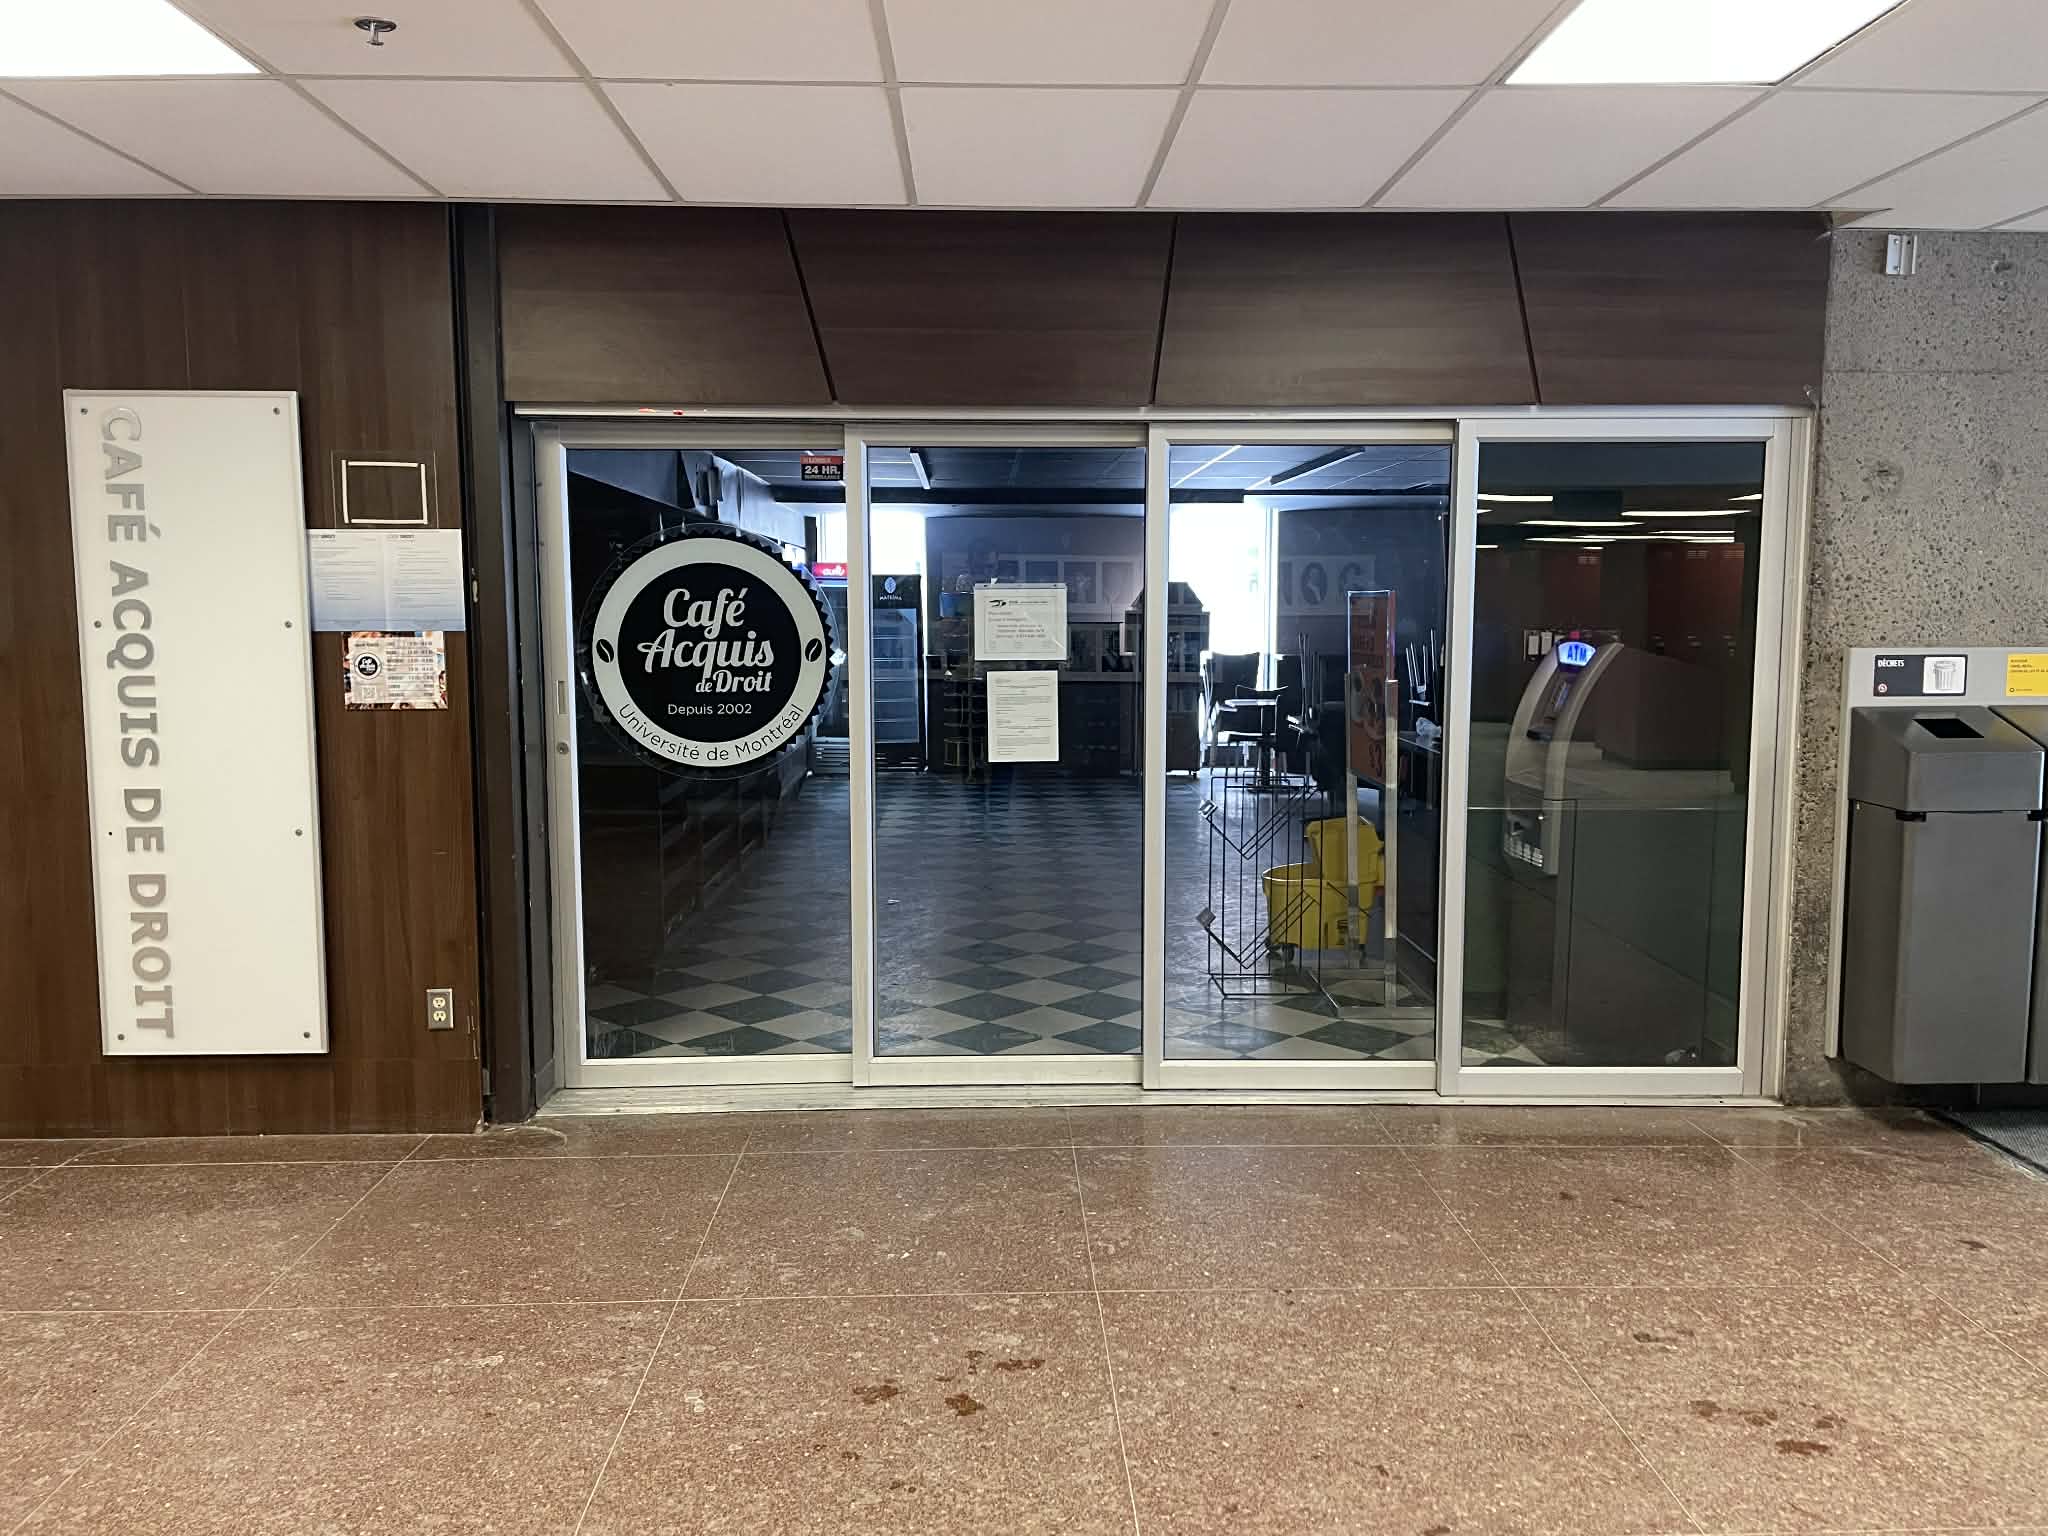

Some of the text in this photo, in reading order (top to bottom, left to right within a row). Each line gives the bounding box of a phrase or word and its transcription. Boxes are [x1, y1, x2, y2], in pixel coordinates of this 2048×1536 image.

[804, 465, 841, 475] 24 HR.
[663, 587, 749, 640] Café
[637, 628, 775, 679] Acquis
[1567, 645, 1587, 662] ATM
[1877, 658, 1905, 668] DÉCHETS
[695, 669, 773, 693] de Droit
[667, 703, 753, 717] Depuis 2002
[99, 406, 175, 1040] CAFÉ ACQUIS DE DROIT
[618, 703, 805, 761] Université de Montréal
